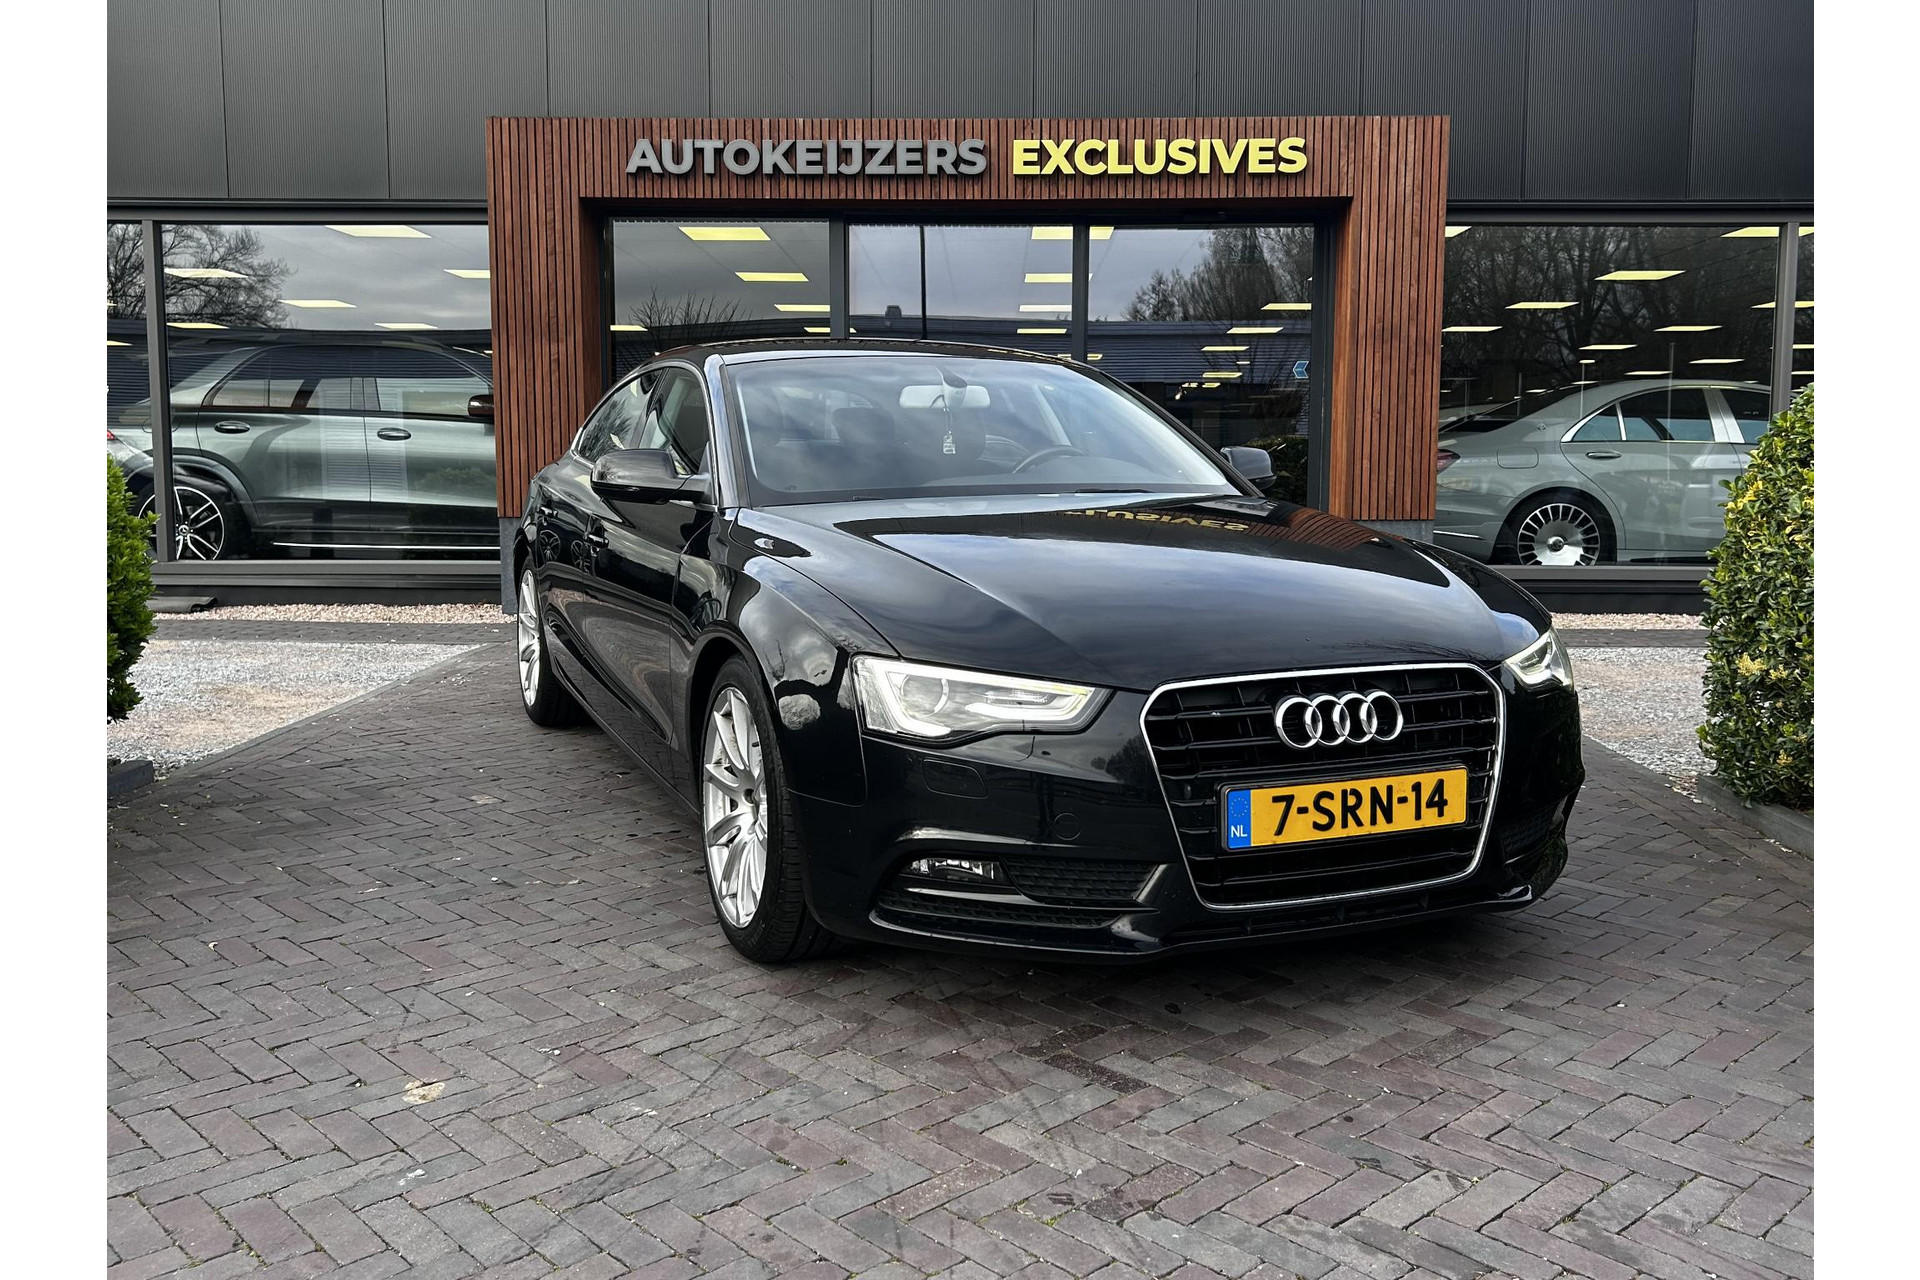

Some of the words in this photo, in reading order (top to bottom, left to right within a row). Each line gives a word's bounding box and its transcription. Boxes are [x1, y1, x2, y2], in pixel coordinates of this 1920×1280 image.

[626, 138, 987, 176] AUTOKEIJZERS
[1013, 137, 1308, 176] EXCLUSIVES
[1271, 778, 1448, 836] 7-SRN-14
[1230, 824, 1248, 838] NL
